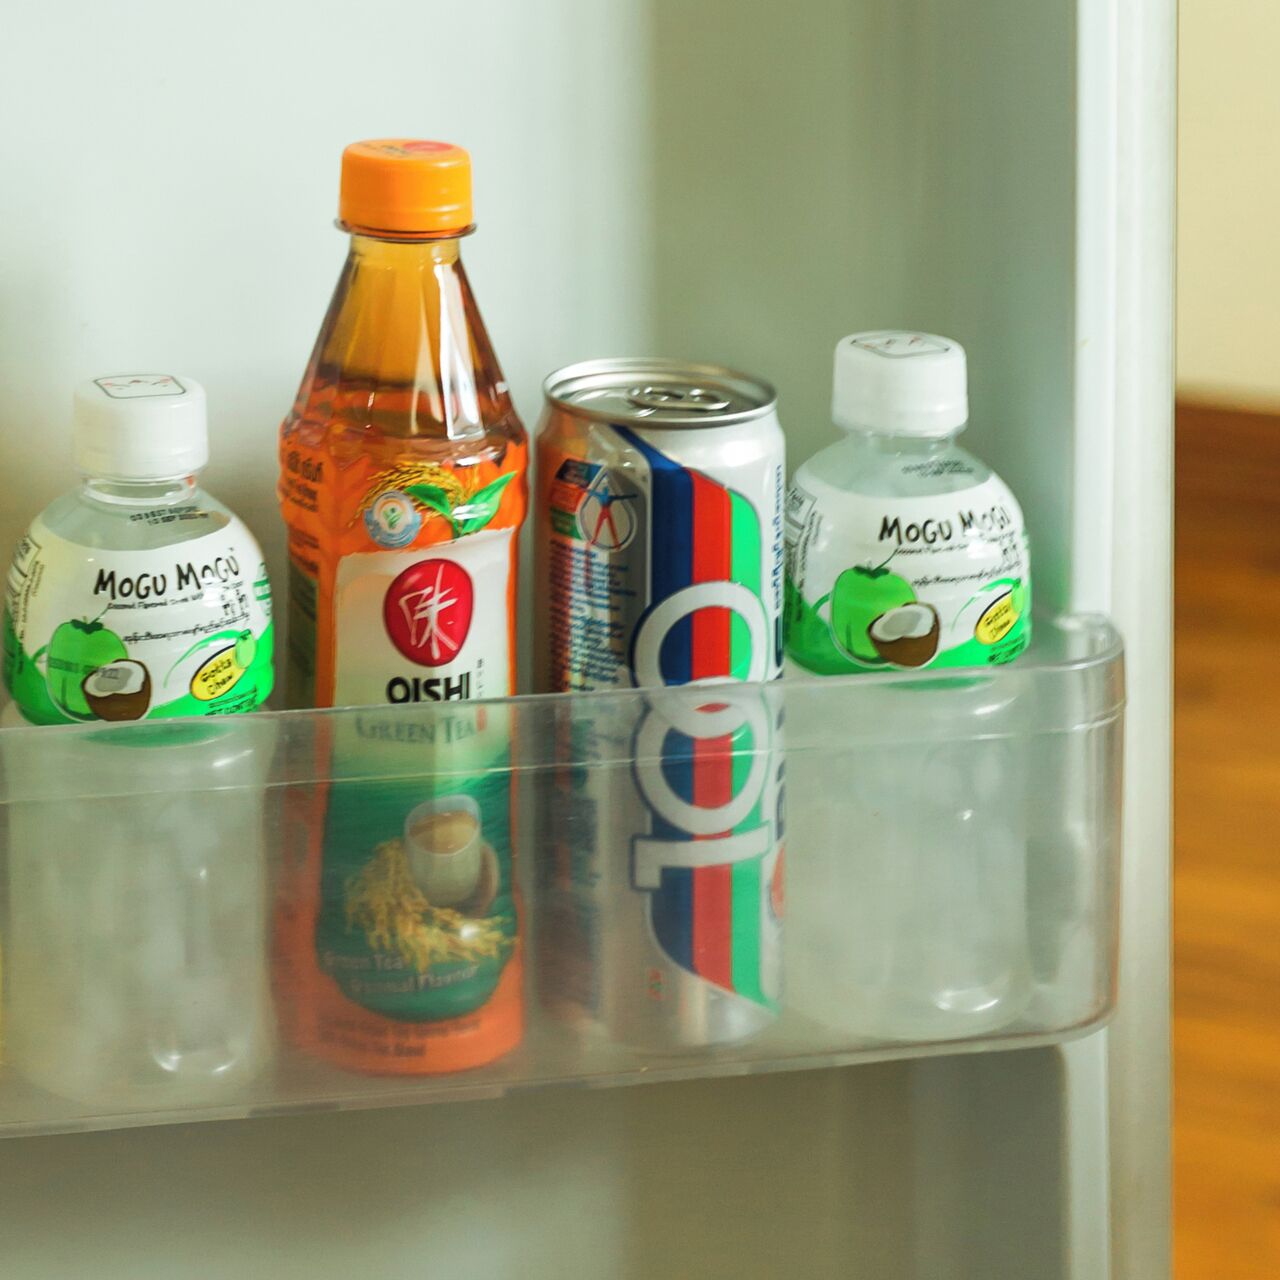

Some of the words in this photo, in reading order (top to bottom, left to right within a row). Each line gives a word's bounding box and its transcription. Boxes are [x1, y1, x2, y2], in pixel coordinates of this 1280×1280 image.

[878, 514, 953, 546] MOGU
[93, 568, 167, 600] MOGU
[386, 672, 472, 705] OISHI
